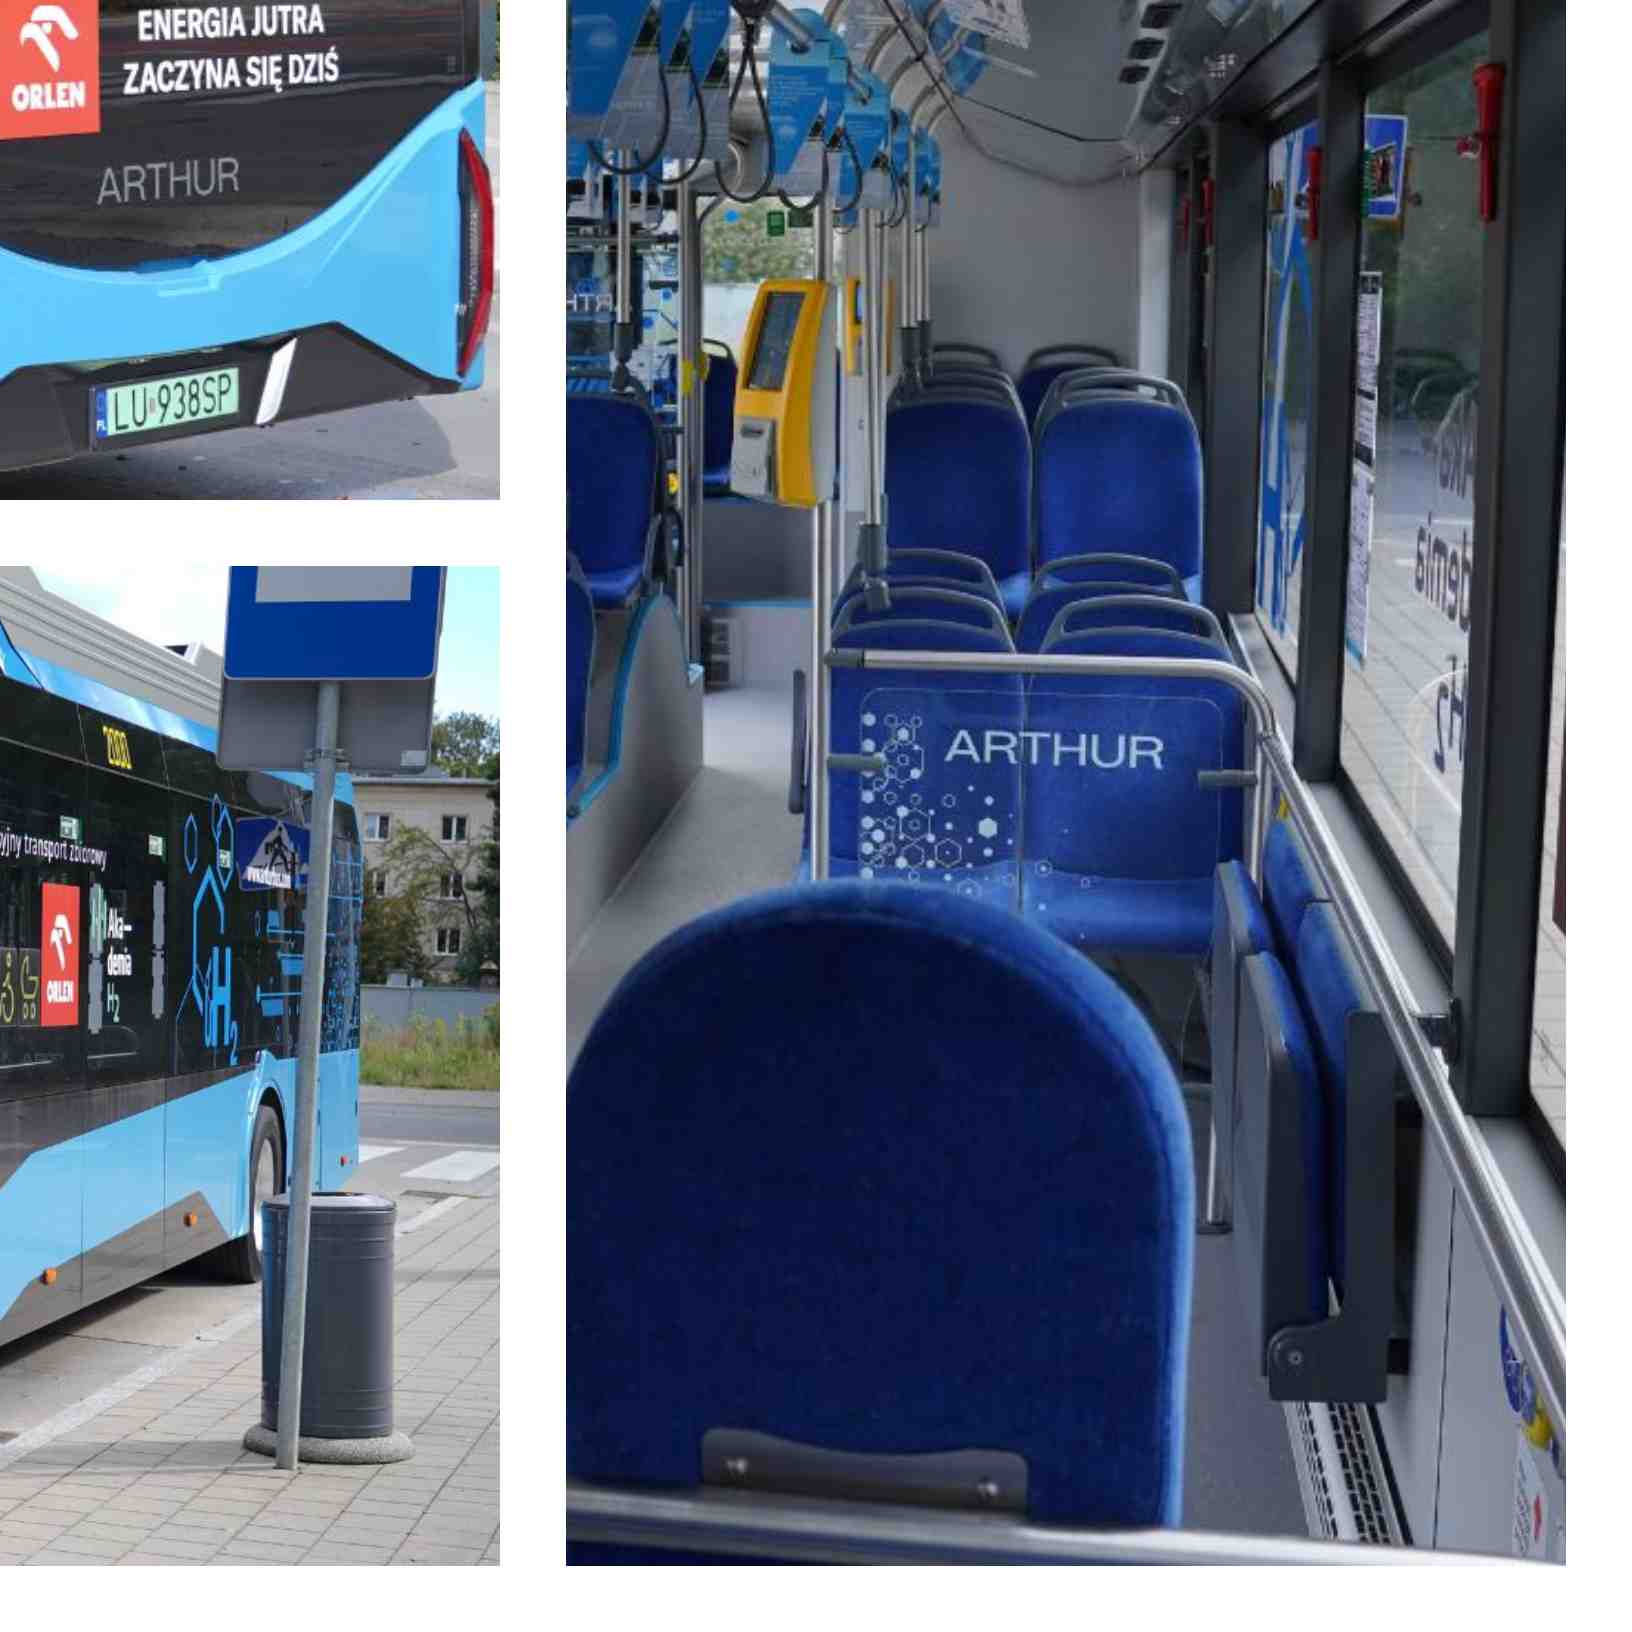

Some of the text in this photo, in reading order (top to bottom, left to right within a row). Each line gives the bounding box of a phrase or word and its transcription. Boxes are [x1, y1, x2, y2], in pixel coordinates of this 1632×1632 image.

[137, 3, 326, 42] ENERGIA JUTRA
[122, 46, 340, 95] ZACZYNA SIĘ DZIŚ
[11, 81, 87, 112] ORLEN
[96, 156, 241, 206] ARTHUR
[113, 372, 232, 432] LU 938SP
[943, 728, 1164, 771] ARTHUR
[23, 834, 68, 865] transport
[106, 945, 133, 977] demia
[46, 979, 74, 1004] ORLEN
